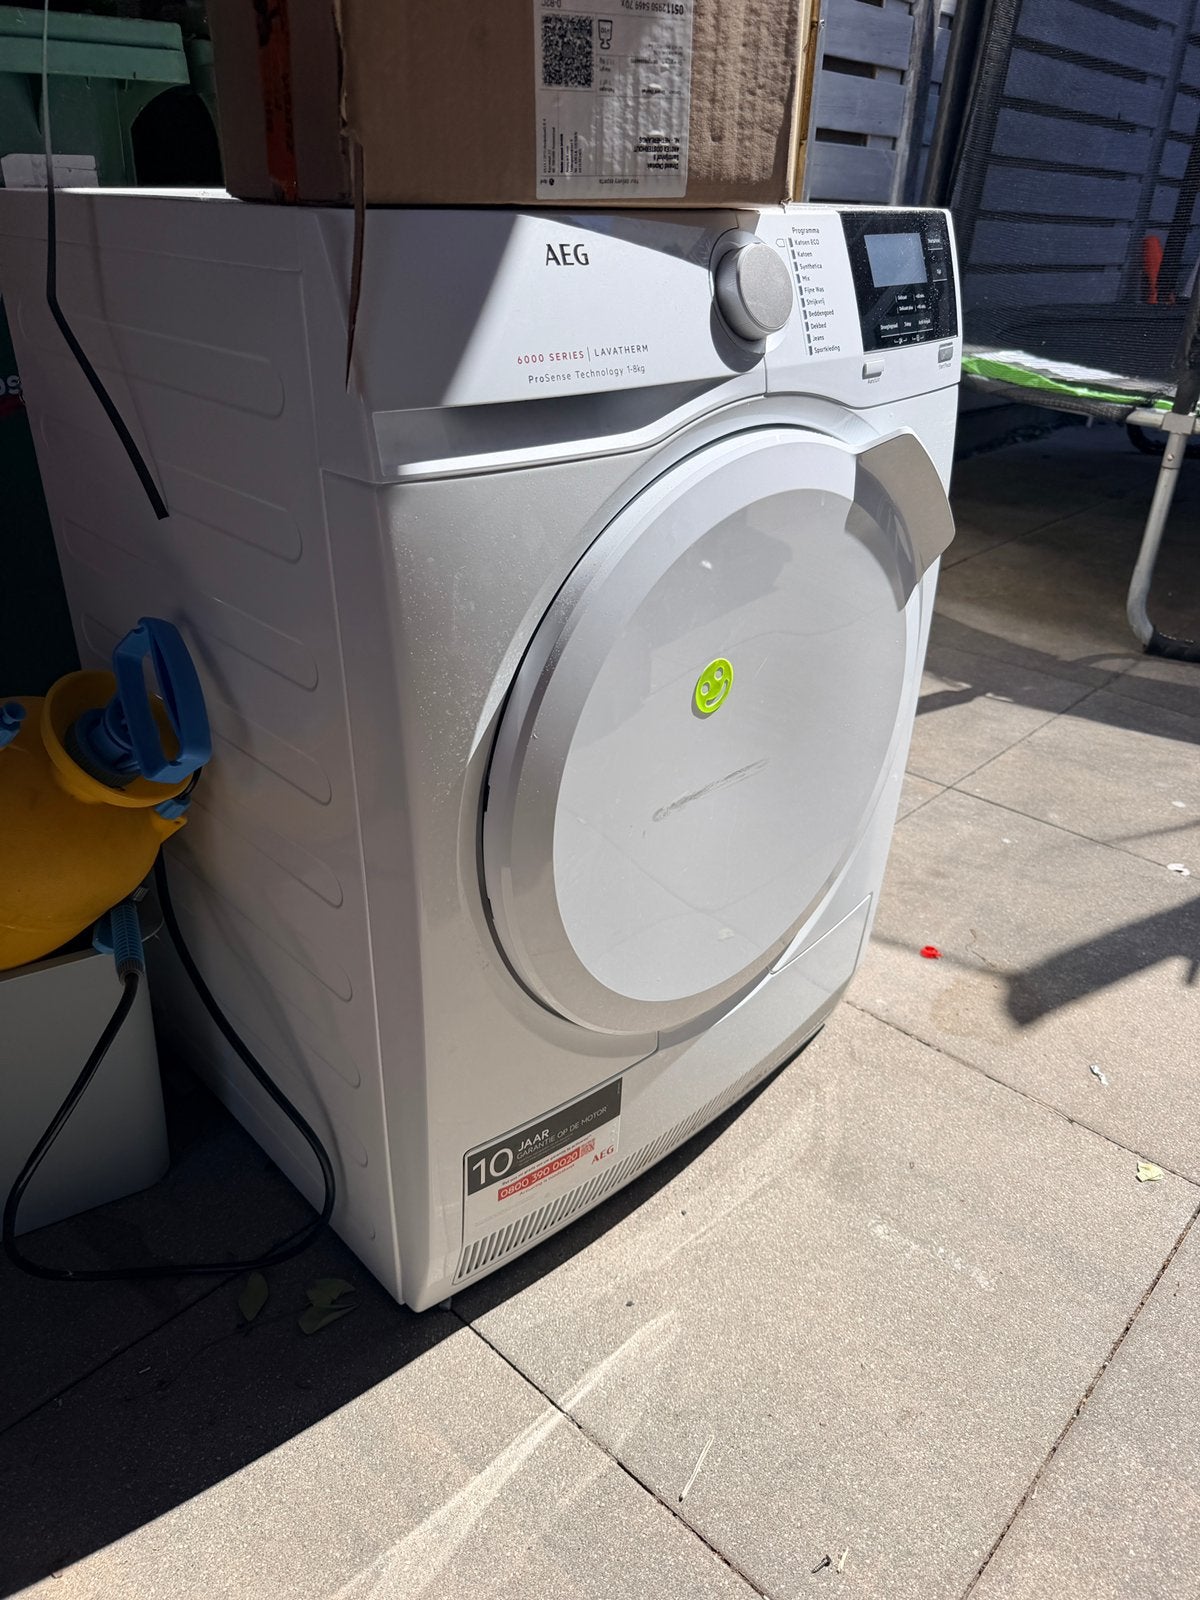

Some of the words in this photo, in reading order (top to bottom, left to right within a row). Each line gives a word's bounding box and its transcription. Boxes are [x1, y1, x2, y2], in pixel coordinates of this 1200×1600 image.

[792, 226, 820, 235] Programma
[546, 244, 590, 266] AEG
[518, 354, 544, 364] 6000
[550, 351, 584, 362] SERIES
[594, 344, 649, 357] LAVATHERM
[528, 373, 572, 384] ProSense
[575, 366, 624, 380] Technology
[516, 1134, 556, 1160] GARANTIE
[557, 1126, 568, 1138] OP
[570, 1121, 580, 1132] DE
[518, 1128, 550, 1152] JAAR
[592, 1145, 614, 1164] AEG
[472, 1148, 514, 1184] 10
[500, 1178, 528, 1198] 0800
[532, 1167, 550, 1183] 390
[552, 1152, 578, 1170] 0020
